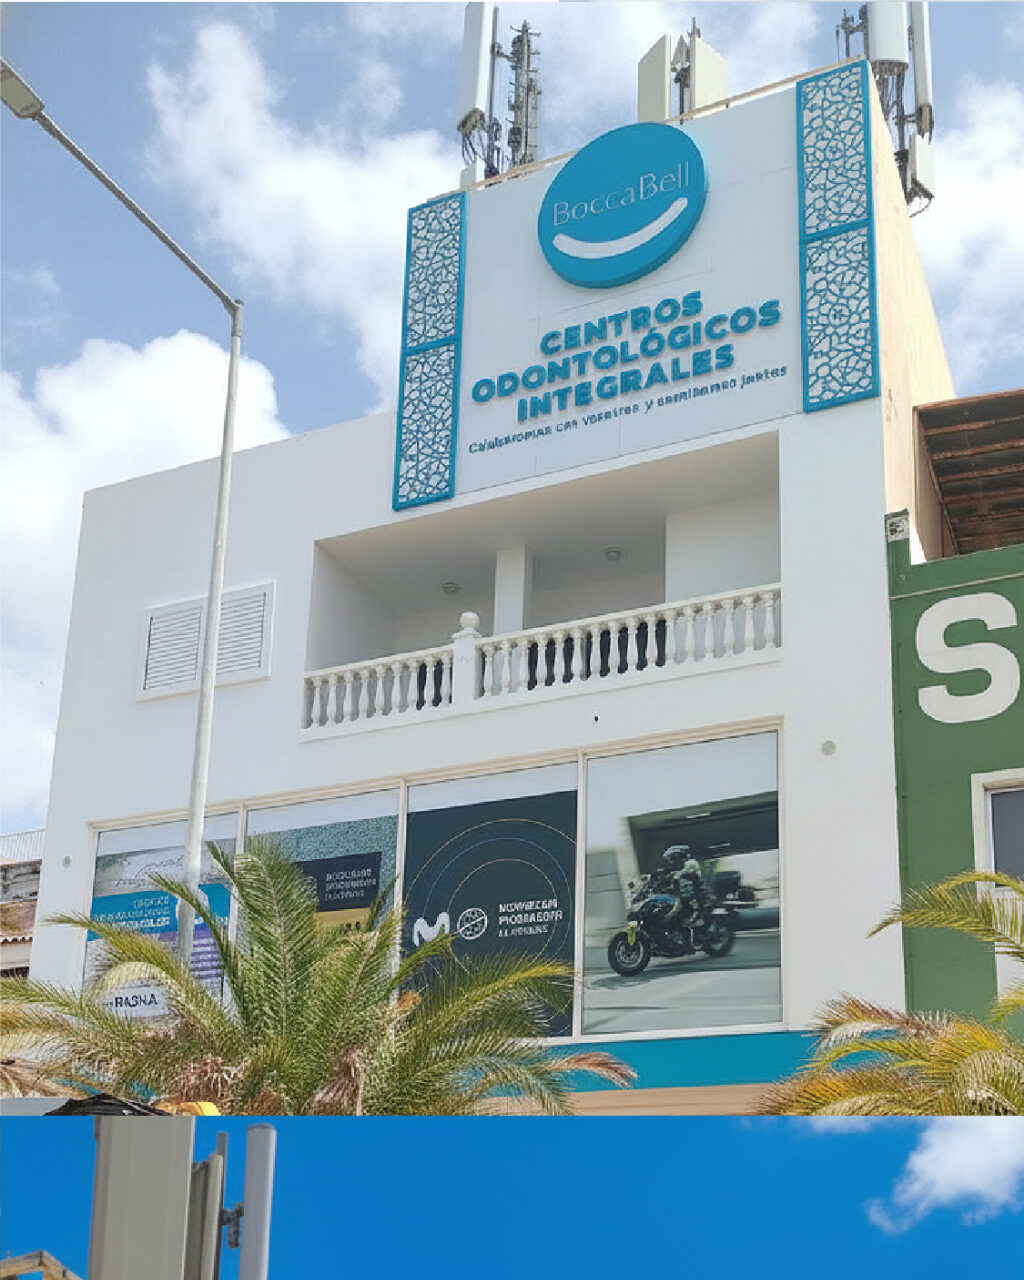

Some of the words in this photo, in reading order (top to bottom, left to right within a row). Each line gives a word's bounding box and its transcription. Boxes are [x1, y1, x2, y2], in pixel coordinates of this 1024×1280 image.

[553, 161, 690, 227] BoccaBell
[472, 300, 781, 403] ODONTOLÓGICOS
[540, 291, 704, 356] CENTROS
[517, 344, 735, 423] INTEGRALES
